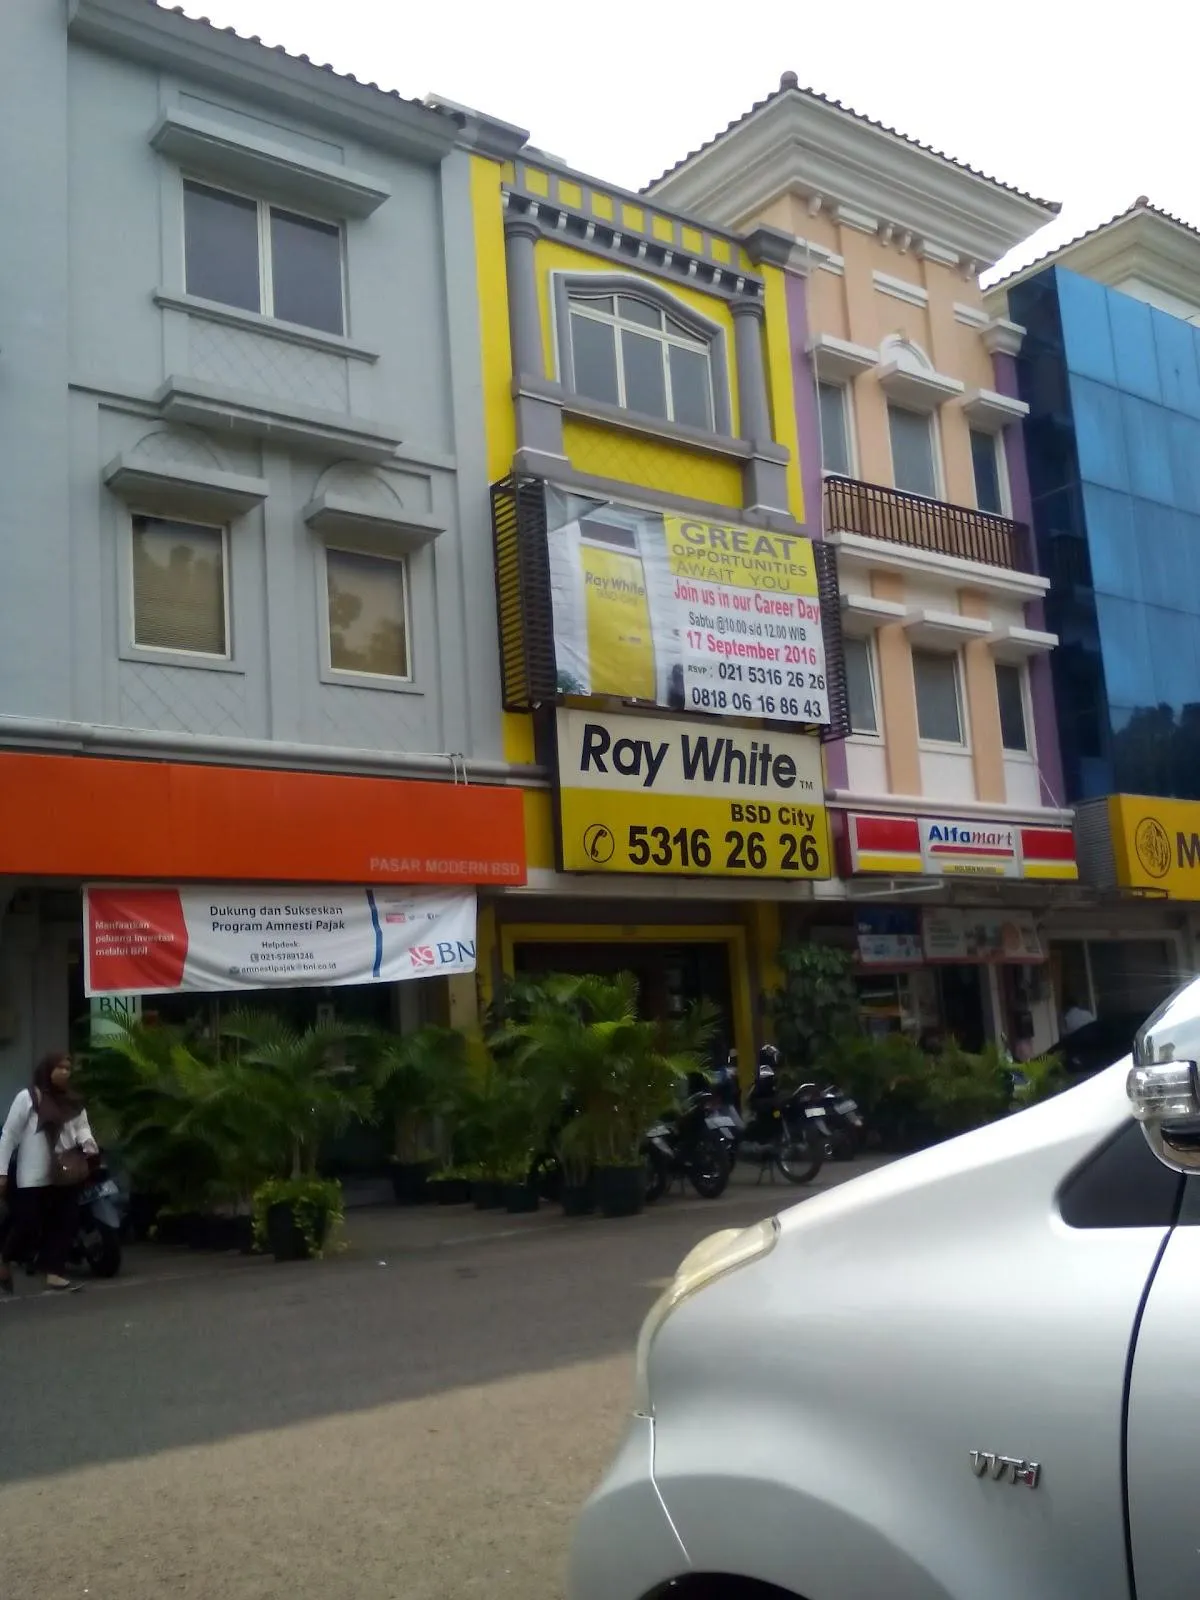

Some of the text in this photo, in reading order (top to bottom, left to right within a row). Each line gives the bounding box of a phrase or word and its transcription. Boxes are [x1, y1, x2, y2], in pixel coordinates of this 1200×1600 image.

[680, 522, 797, 560] GREAT
[672, 544, 808, 577] OPPORTUNITIES
[676, 560, 790, 591] AWAIT YOU
[585, 571, 608, 590] Ray
[674, 580, 820, 625] Join us in our Career Day
[688, 611, 715, 628] Sabtu
[716, 616, 747, 635] @10.00
[764, 624, 787, 640] 12.00
[788, 626, 807, 641] WIB
[687, 631, 817, 666] 17 September 2016
[718, 662, 743, 682] 021
[748, 666, 782, 686] 5316
[786, 671, 804, 688] 26
[809, 673, 825, 690] 26
[692, 687, 822, 718] 0818 06 16 86 43
[580, 724, 670, 787] Ray
[680, 734, 797, 788] White
[731, 804, 815, 831] BSD City
[629, 825, 819, 872] 5316 26 26
[928, 824, 1013, 846] Alfamart
[369, 858, 520, 877] PASAR MODERN BSD
[210, 905, 343, 919] Dukung dan Sukseskan
[212, 919, 346, 933] Program Amnesti Pajak
[100, 996, 136, 1013] BNI
